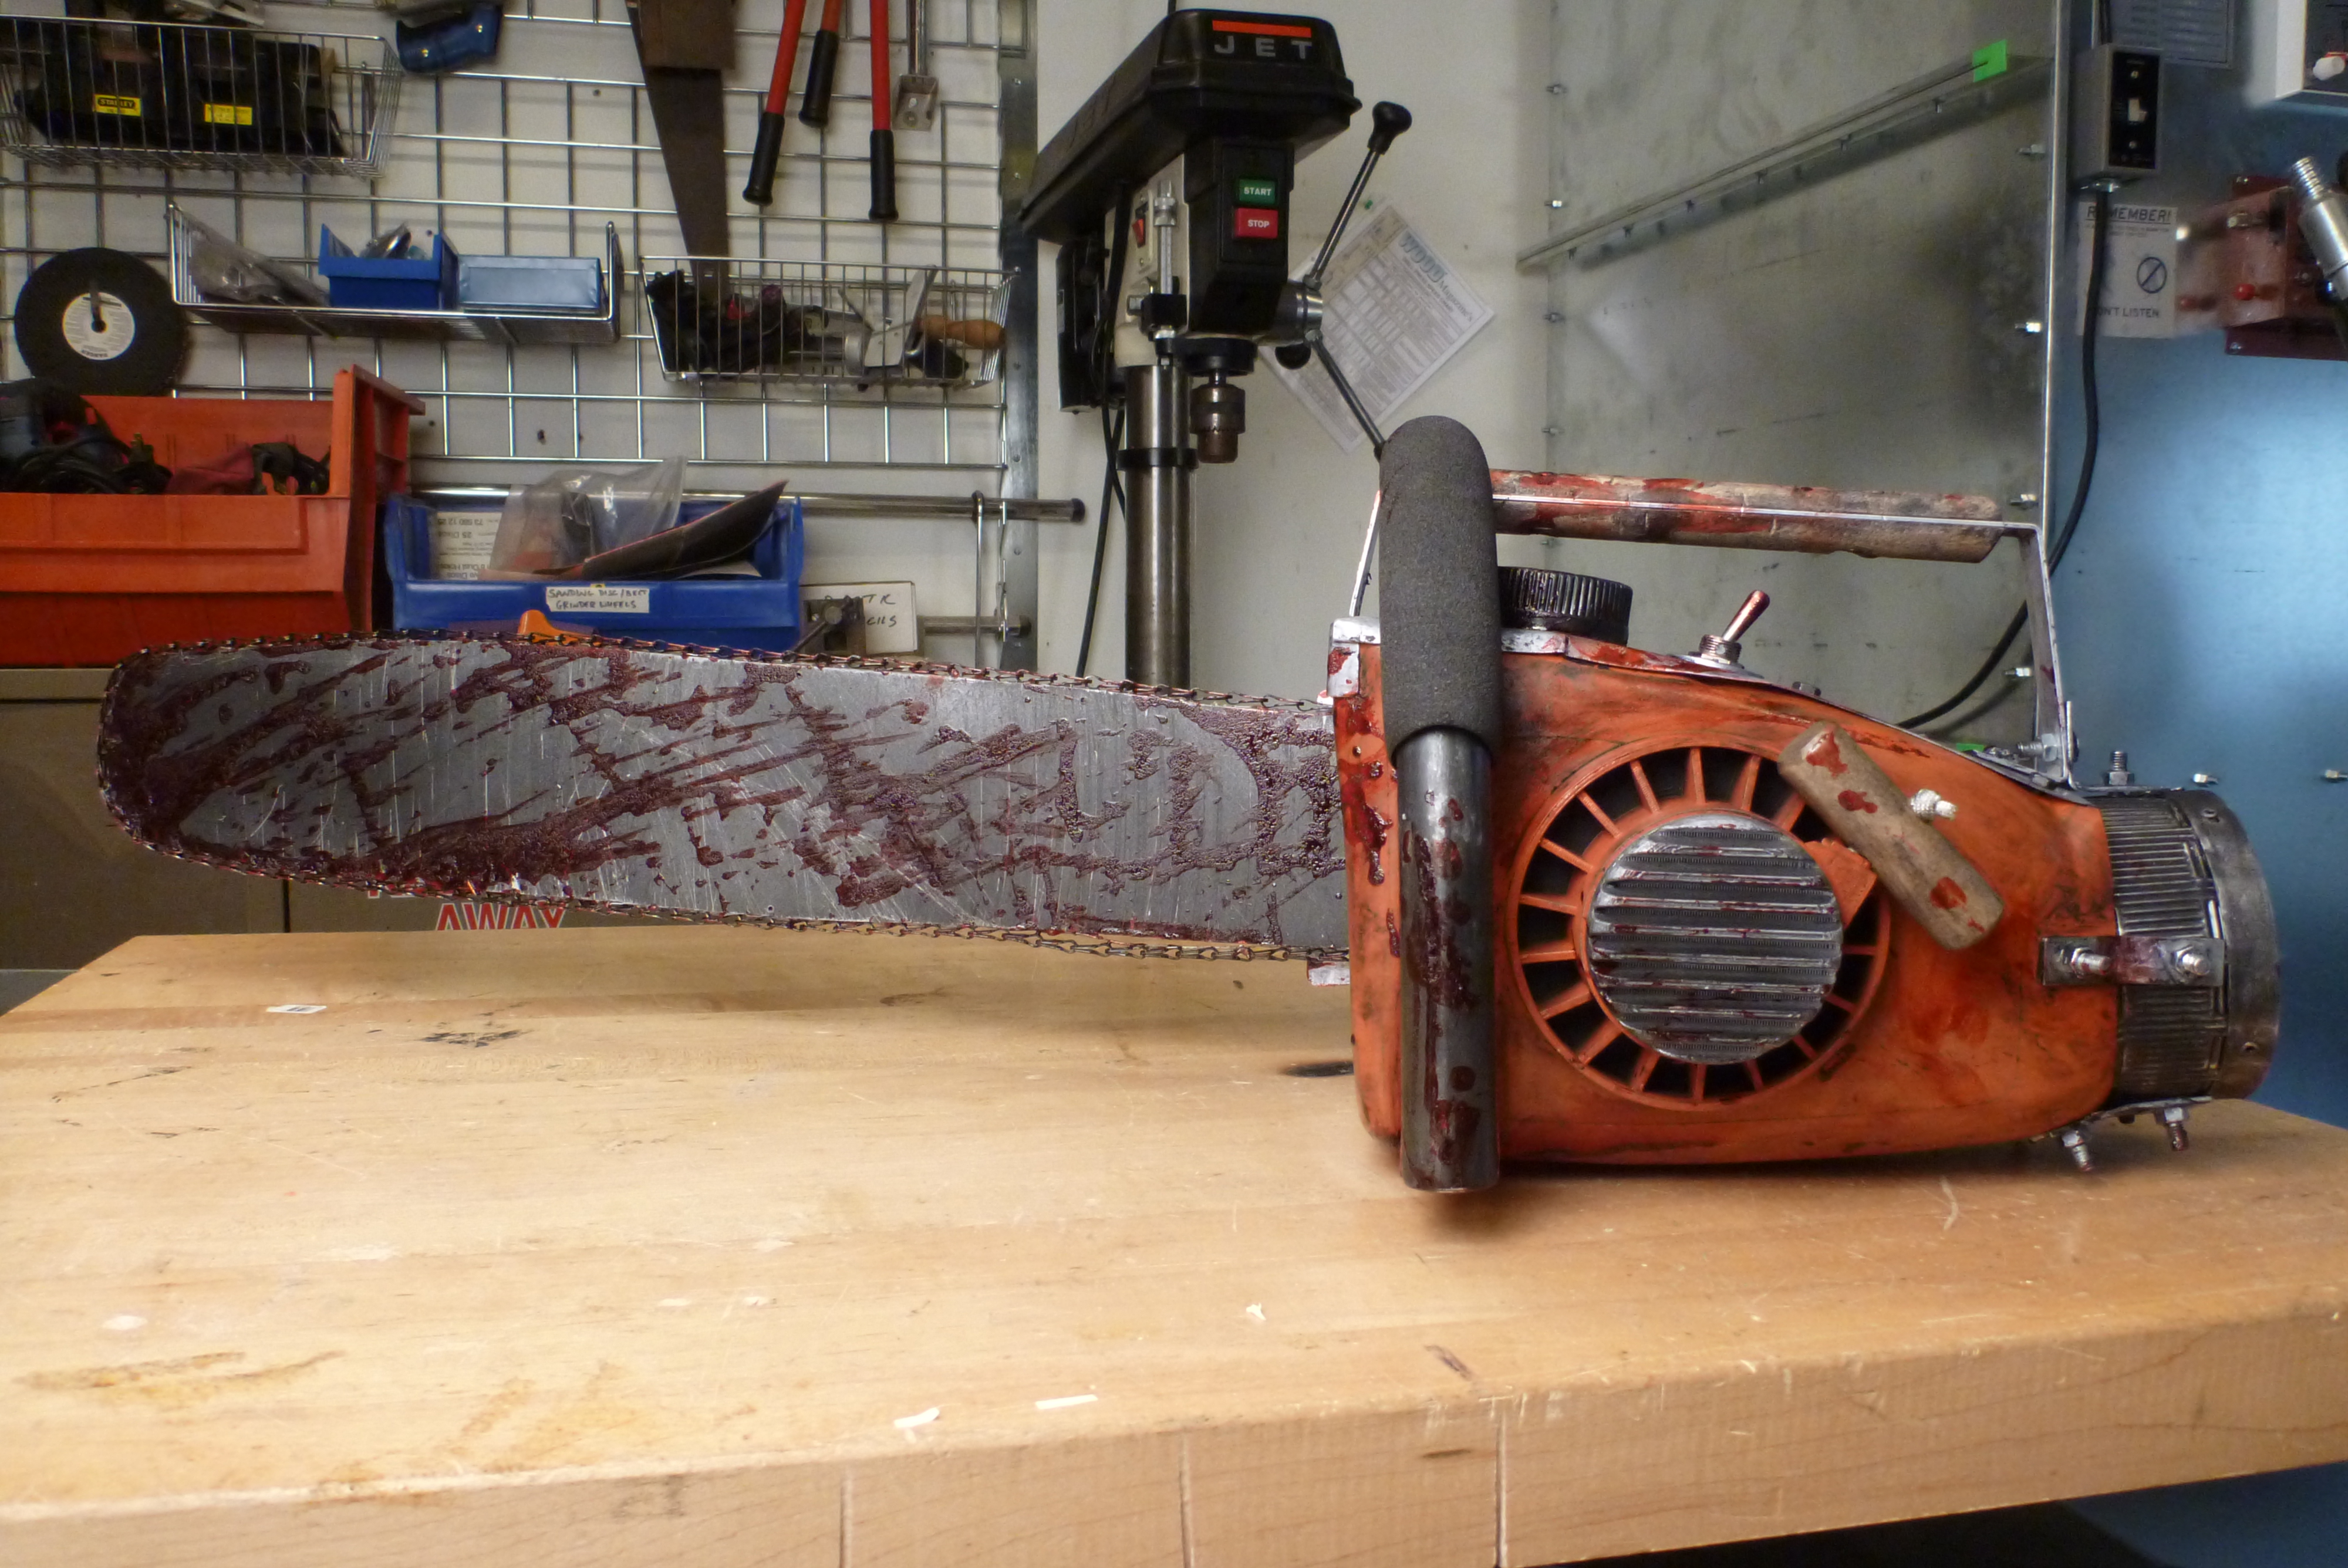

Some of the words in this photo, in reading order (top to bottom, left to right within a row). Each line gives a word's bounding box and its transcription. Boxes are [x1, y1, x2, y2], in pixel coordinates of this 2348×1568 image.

[1214, 35, 1313, 59] JET
[1243, 187, 1271, 196] START
[2087, 205, 2172, 222] RMEMBER!
[1247, 219, 1270, 228] STOP
[2123, 307, 2160, 317] LISTEN
[556, 600, 596, 610] GRINDER
[436, 903, 566, 930] AWAY
